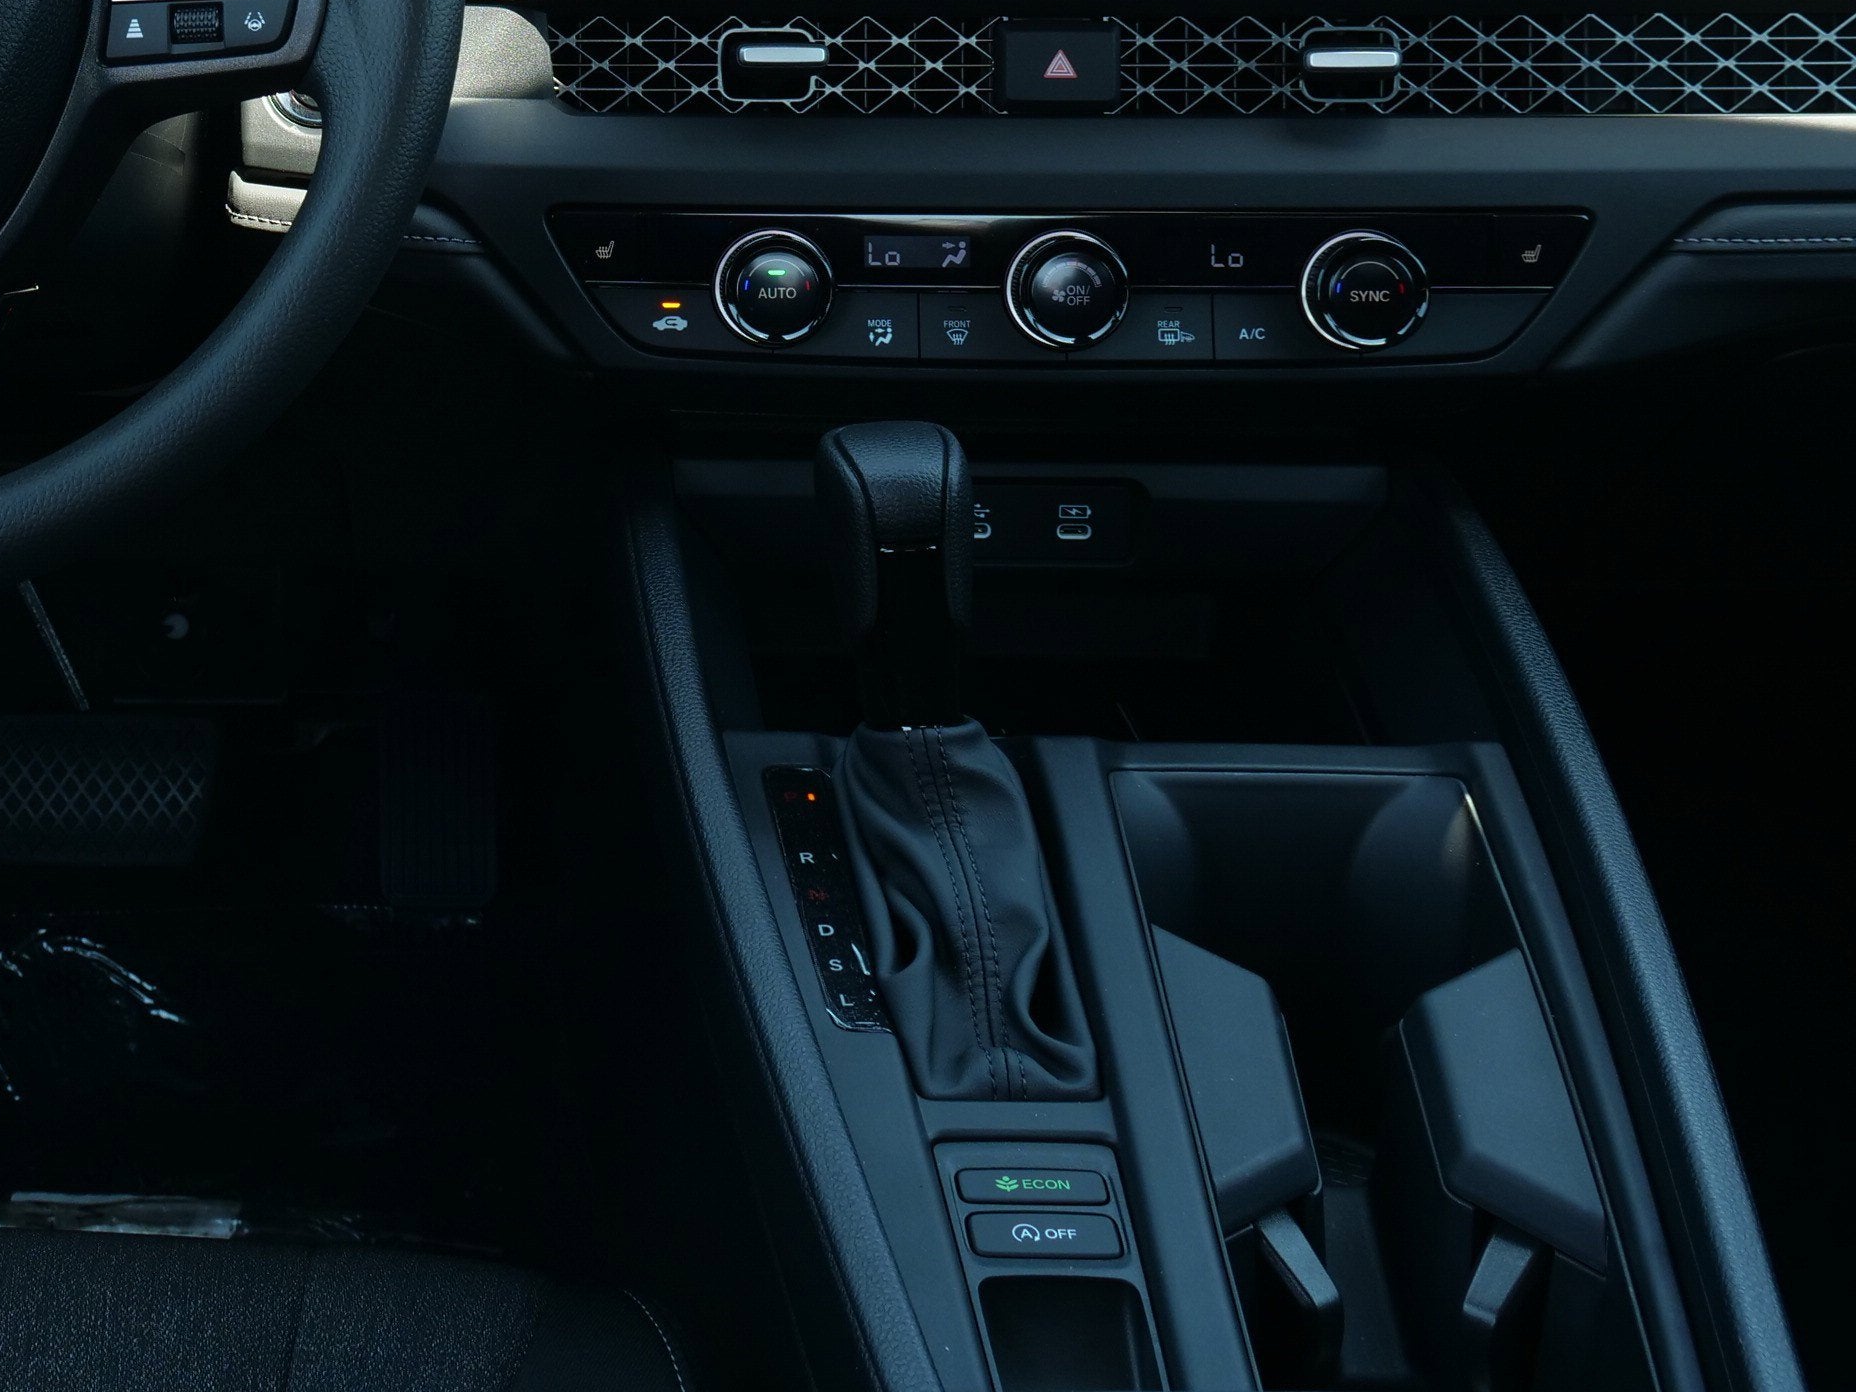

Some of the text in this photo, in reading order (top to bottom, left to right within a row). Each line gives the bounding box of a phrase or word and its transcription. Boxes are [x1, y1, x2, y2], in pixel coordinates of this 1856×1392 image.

[868, 242, 900, 266] Lo
[1211, 244, 1243, 268] Lo
[758, 287, 797, 299] AUTO
[1066, 285, 1090, 296] ON/
[1349, 290, 1390, 303] SYNC
[1067, 296, 1091, 306] OFF
[867, 319, 892, 327] MODE
[944, 320, 971, 328] FRONT
[1157, 320, 1180, 328] REAR
[1239, 328, 1265, 340] A/C
[799, 852, 815, 864] R
[818, 924, 835, 937] D
[829, 959, 843, 972] S
[839, 994, 854, 1007] L
[1022, 1179, 1071, 1190] ECON
[1045, 1229, 1077, 1240] OFF
